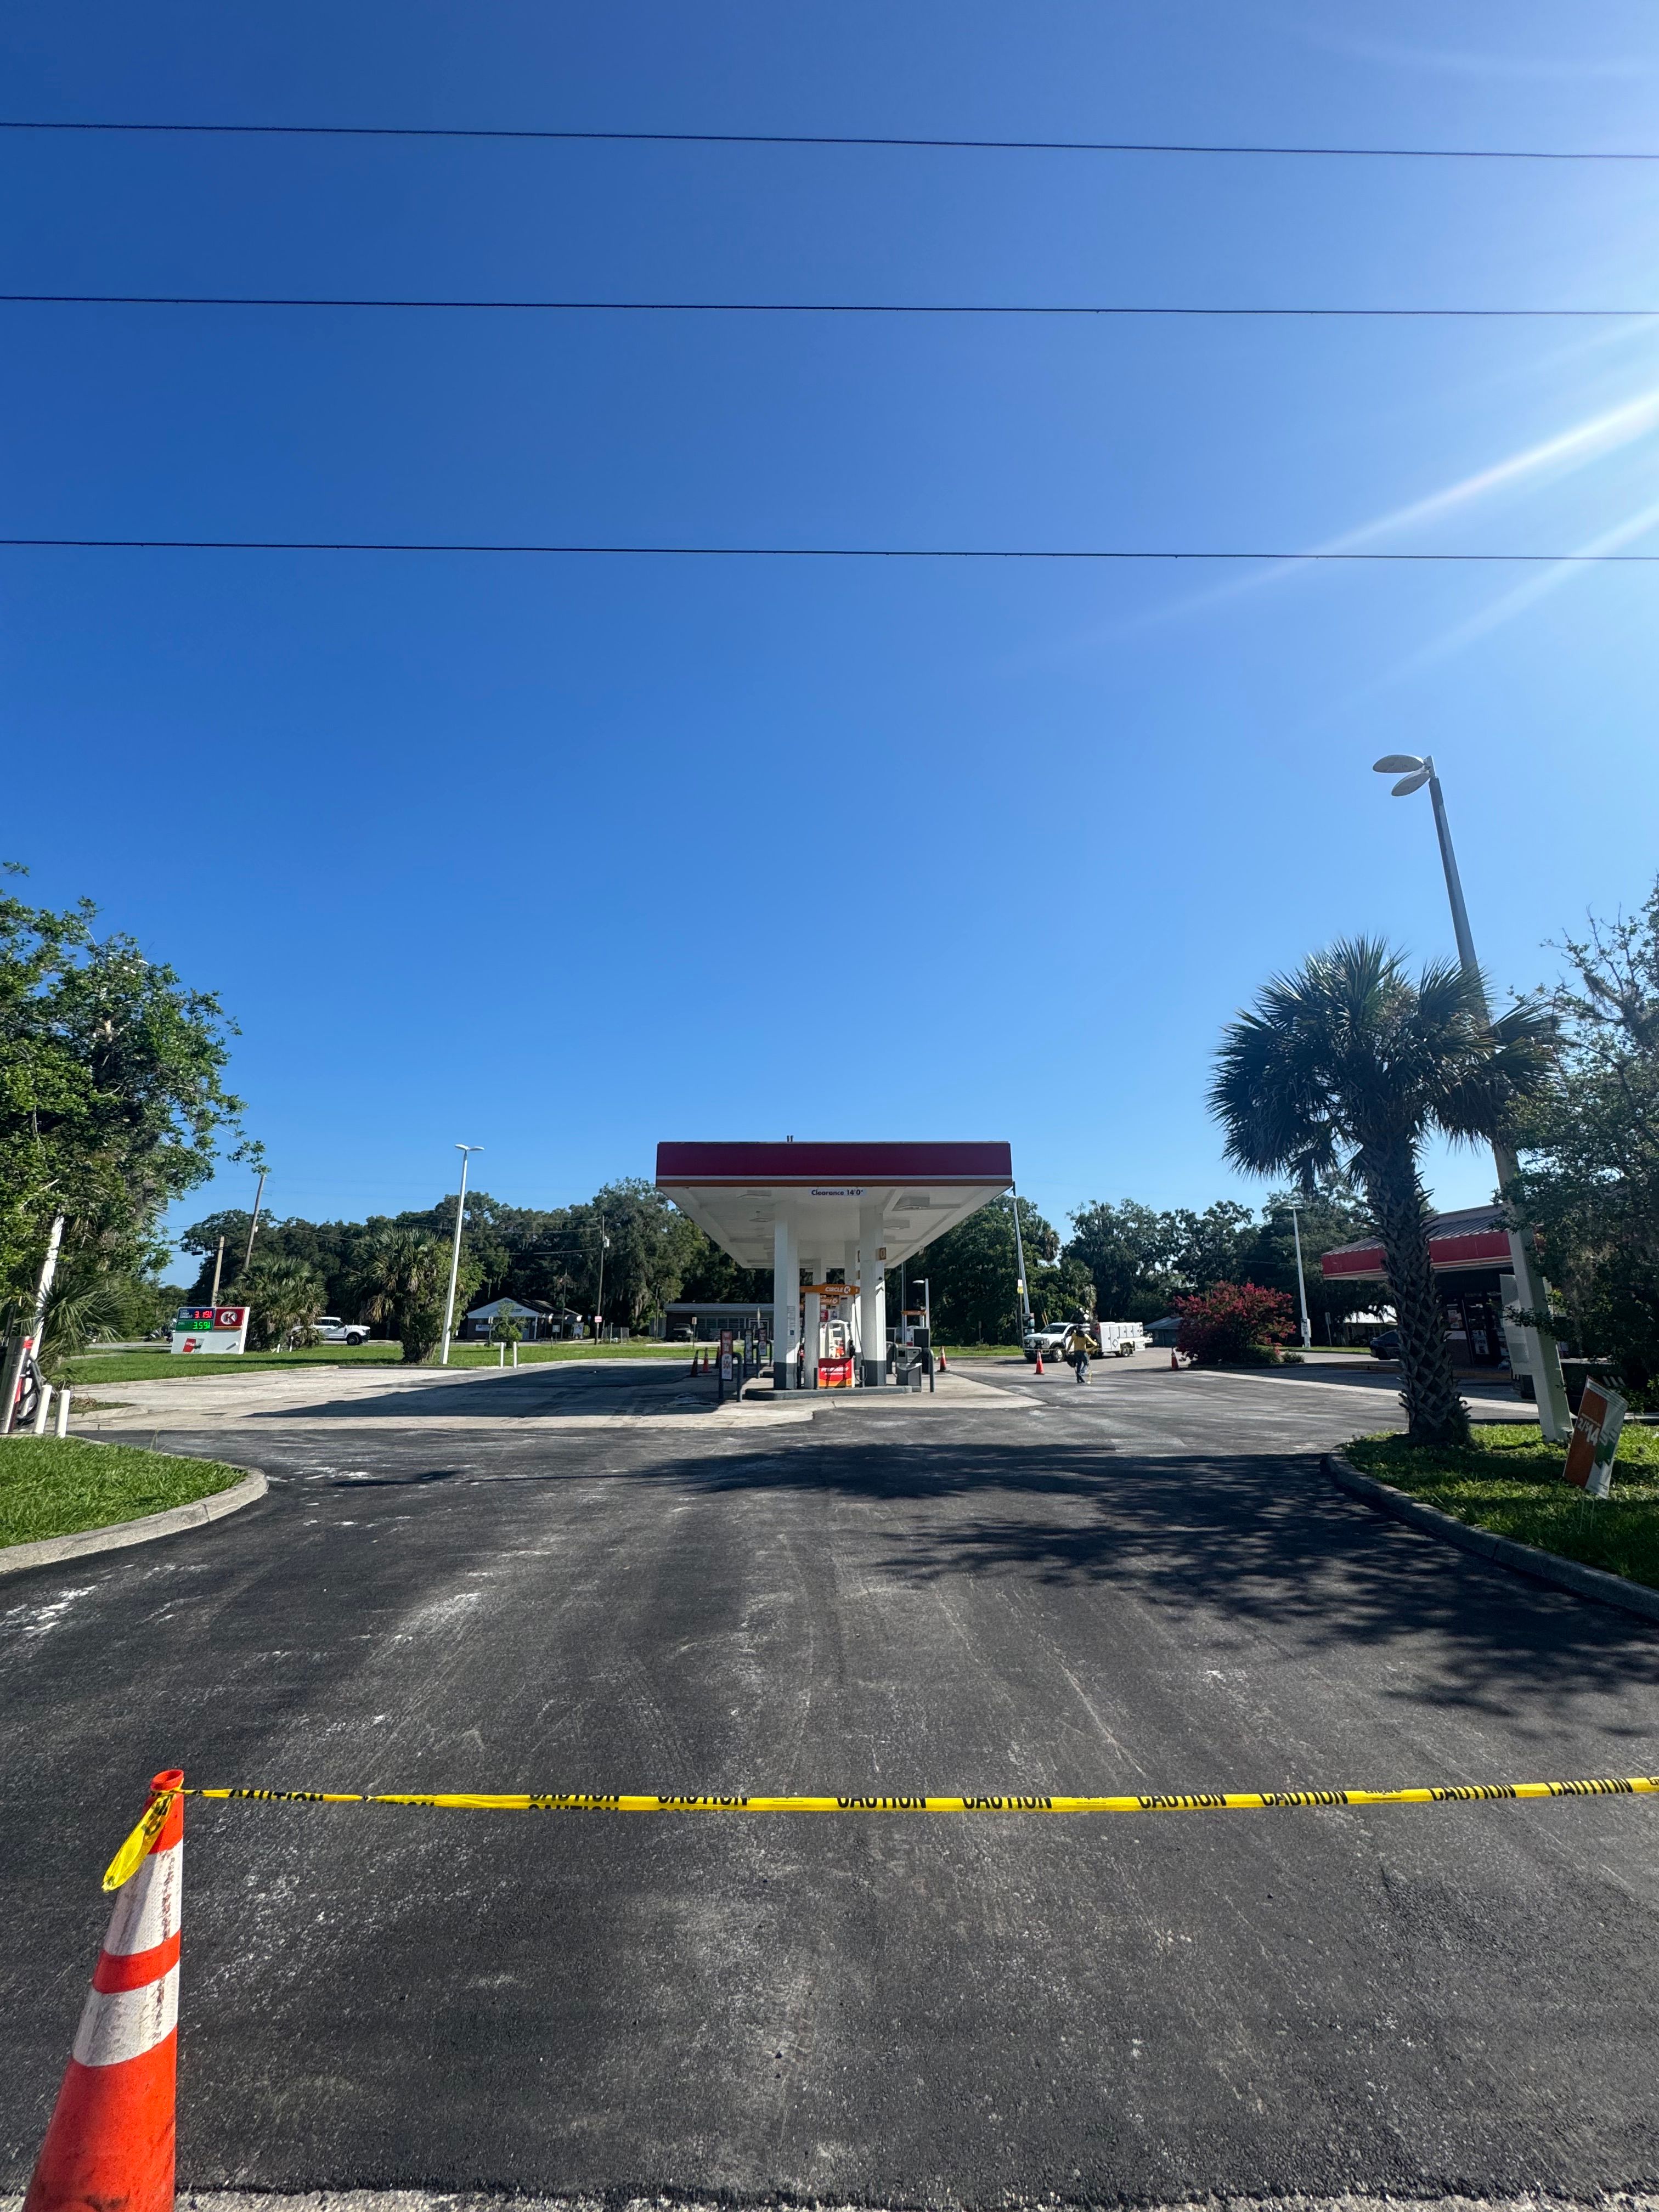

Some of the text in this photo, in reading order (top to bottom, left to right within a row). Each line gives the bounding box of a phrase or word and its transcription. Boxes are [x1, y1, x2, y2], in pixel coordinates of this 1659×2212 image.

[837, 1798, 927, 1808] CAUTION
[962, 1797, 1052, 1809] CAUTION
[1137, 1795, 1227, 1809] CAUTION
[1260, 1791, 1348, 1806] CAUTION
